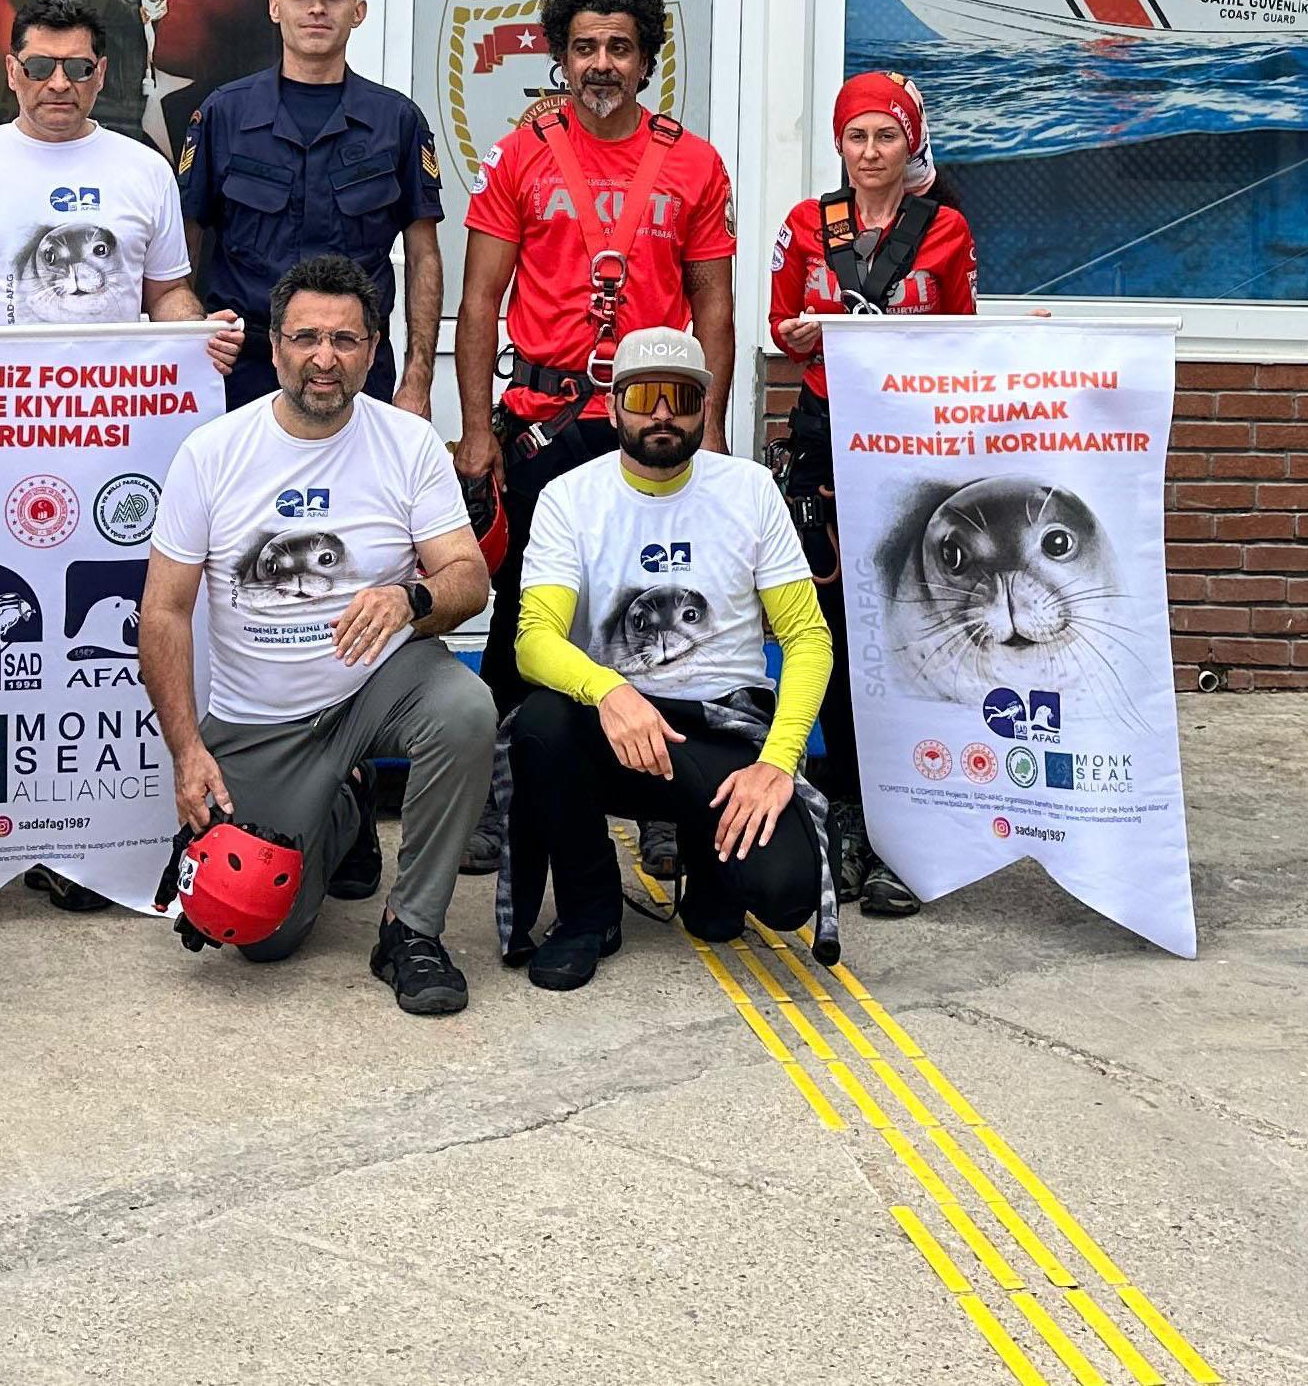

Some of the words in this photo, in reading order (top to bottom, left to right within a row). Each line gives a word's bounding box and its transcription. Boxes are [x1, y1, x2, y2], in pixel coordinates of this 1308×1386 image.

[1219, 8, 1257, 21] COAST
[1263, 12, 1296, 25] GUARD
[639, 343, 690, 359] NOVA
[39, 363, 179, 389] FOKUNUN
[882, 370, 995, 393] AKDENİZ
[1007, 370, 1118, 391] FOKUNU
[14, 390, 199, 418] KIYILARINDA
[934, 400, 1068, 425] KORUMAK
[985, 432, 1150, 456] KORUMAKTIR
[856, 556, 887, 699] SAD-AFAG
[4, 651, 43, 677] SAD
[6, 679, 42, 690] 1994
[15, 711, 160, 741] MONK
[1032, 733, 1061, 744] AFAG
[14, 744, 159, 774] SEAL
[1076, 754, 1132, 767] MONK
[1077, 768, 1132, 781] SEAL
[12, 775, 160, 804] ALLIANCE
[1076, 781, 1133, 793] ALLIANCE
[18, 817, 91, 831] sadafag1987
